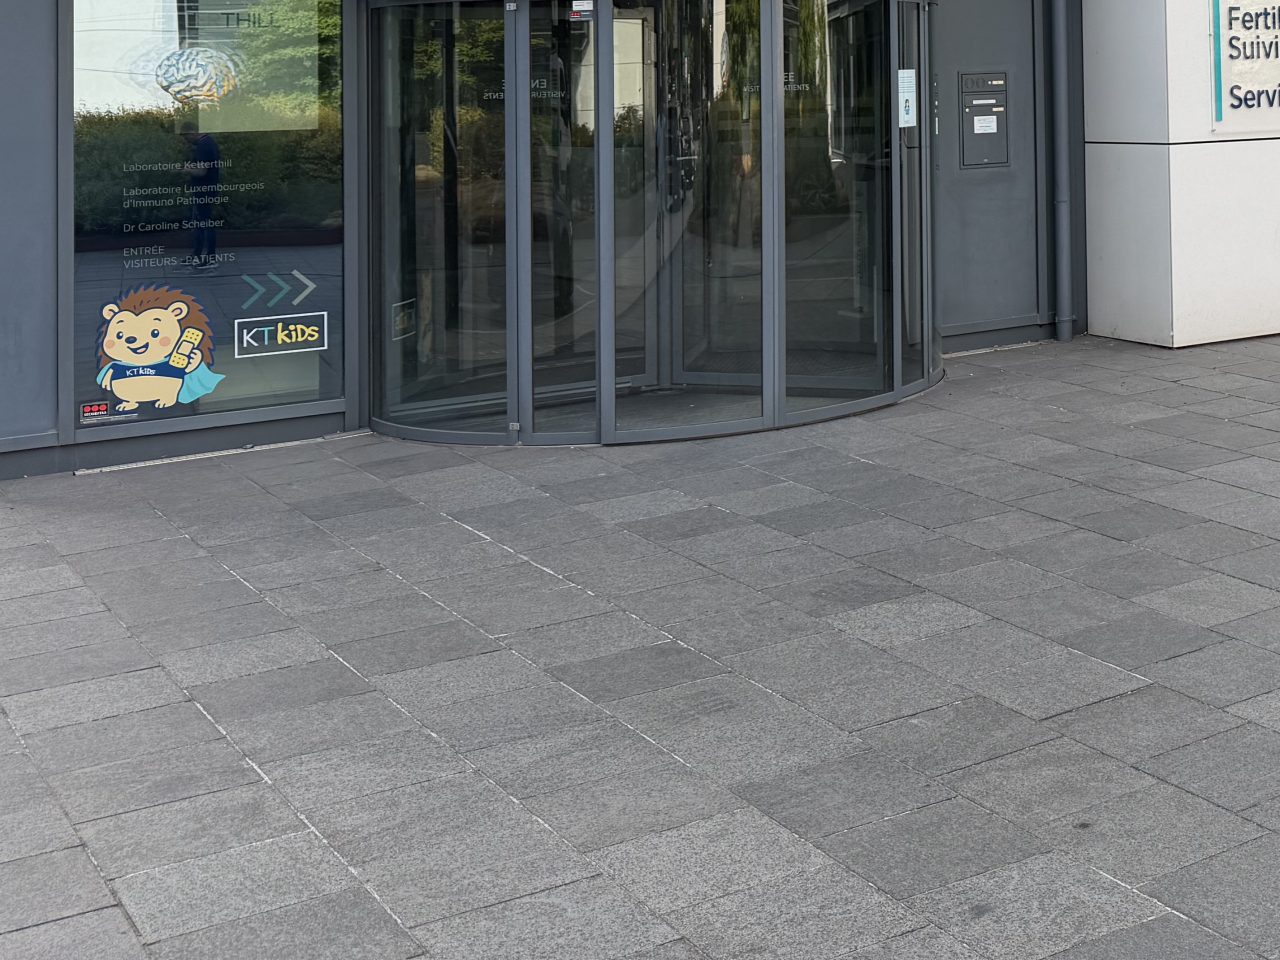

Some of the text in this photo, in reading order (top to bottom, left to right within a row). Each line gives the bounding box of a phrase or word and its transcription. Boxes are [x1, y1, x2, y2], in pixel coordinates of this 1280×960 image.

[1228, 35, 1279, 60] Suivi
[123, 159, 232, 172] Laboratoire Ketterthill
[123, 182, 264, 196] Laboratoire Luxembourgeois
[177, 195, 229, 206] Pathologie
[123, 223, 135, 232] Dr
[138, 221, 179, 232] Caroline
[123, 257, 177, 269] VISITEURS
[186, 253, 236, 265] PATIENTS
